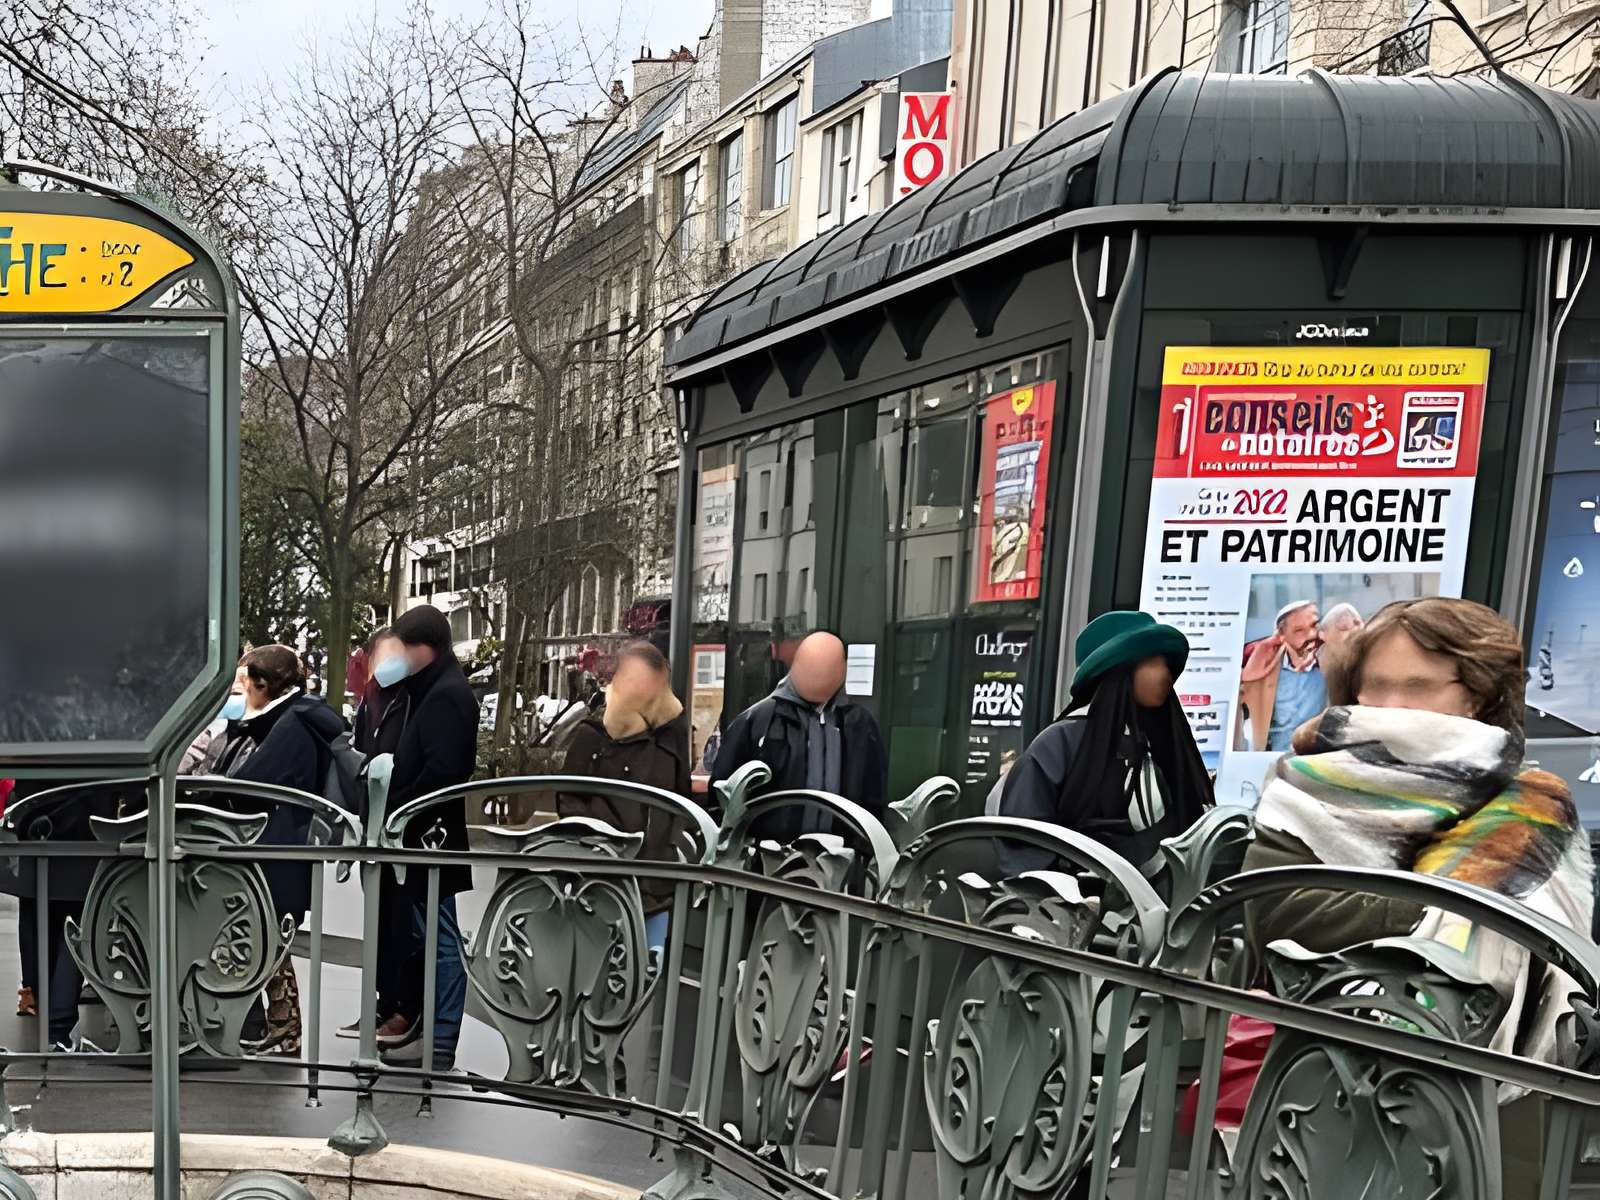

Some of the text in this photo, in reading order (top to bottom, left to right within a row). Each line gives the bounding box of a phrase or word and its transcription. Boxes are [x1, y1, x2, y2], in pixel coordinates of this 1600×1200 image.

[900, 94, 951, 193] MO
[1296, 488, 1451, 523] ARGENT
[1160, 528, 1446, 563] ET PATRIMOINE
